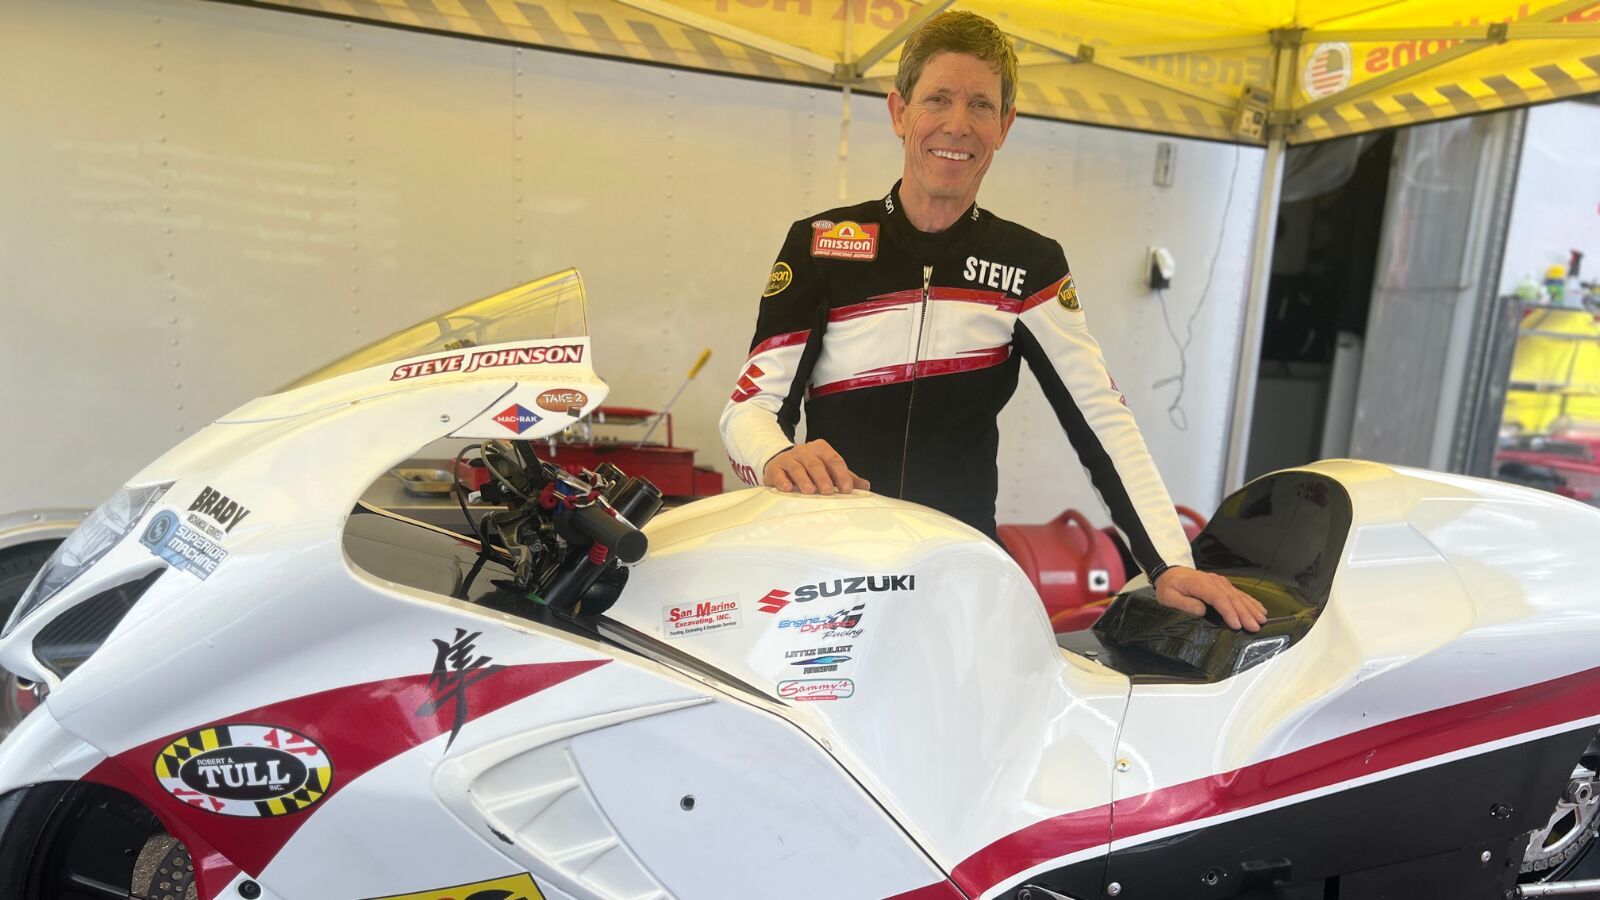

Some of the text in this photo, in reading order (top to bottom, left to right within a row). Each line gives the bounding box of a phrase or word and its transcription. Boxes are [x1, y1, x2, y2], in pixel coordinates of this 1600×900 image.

[963, 256, 1027, 297] STEVE
[390, 344, 584, 381] STEVE JOHNSON
[543, 393, 583, 404] TAKE 2
[187, 485, 251, 534] BRADY
[168, 537, 218, 573] MACHINE
[175, 524, 228, 562] SUPERIOR
[795, 574, 915, 602] SUZUKI
[778, 615, 827, 629] Engine
[823, 628, 864, 640] Racing
[780, 680, 849, 697] Sammy's
[197, 757, 225, 766] ROBERT
[198, 760, 291, 788] TULL
